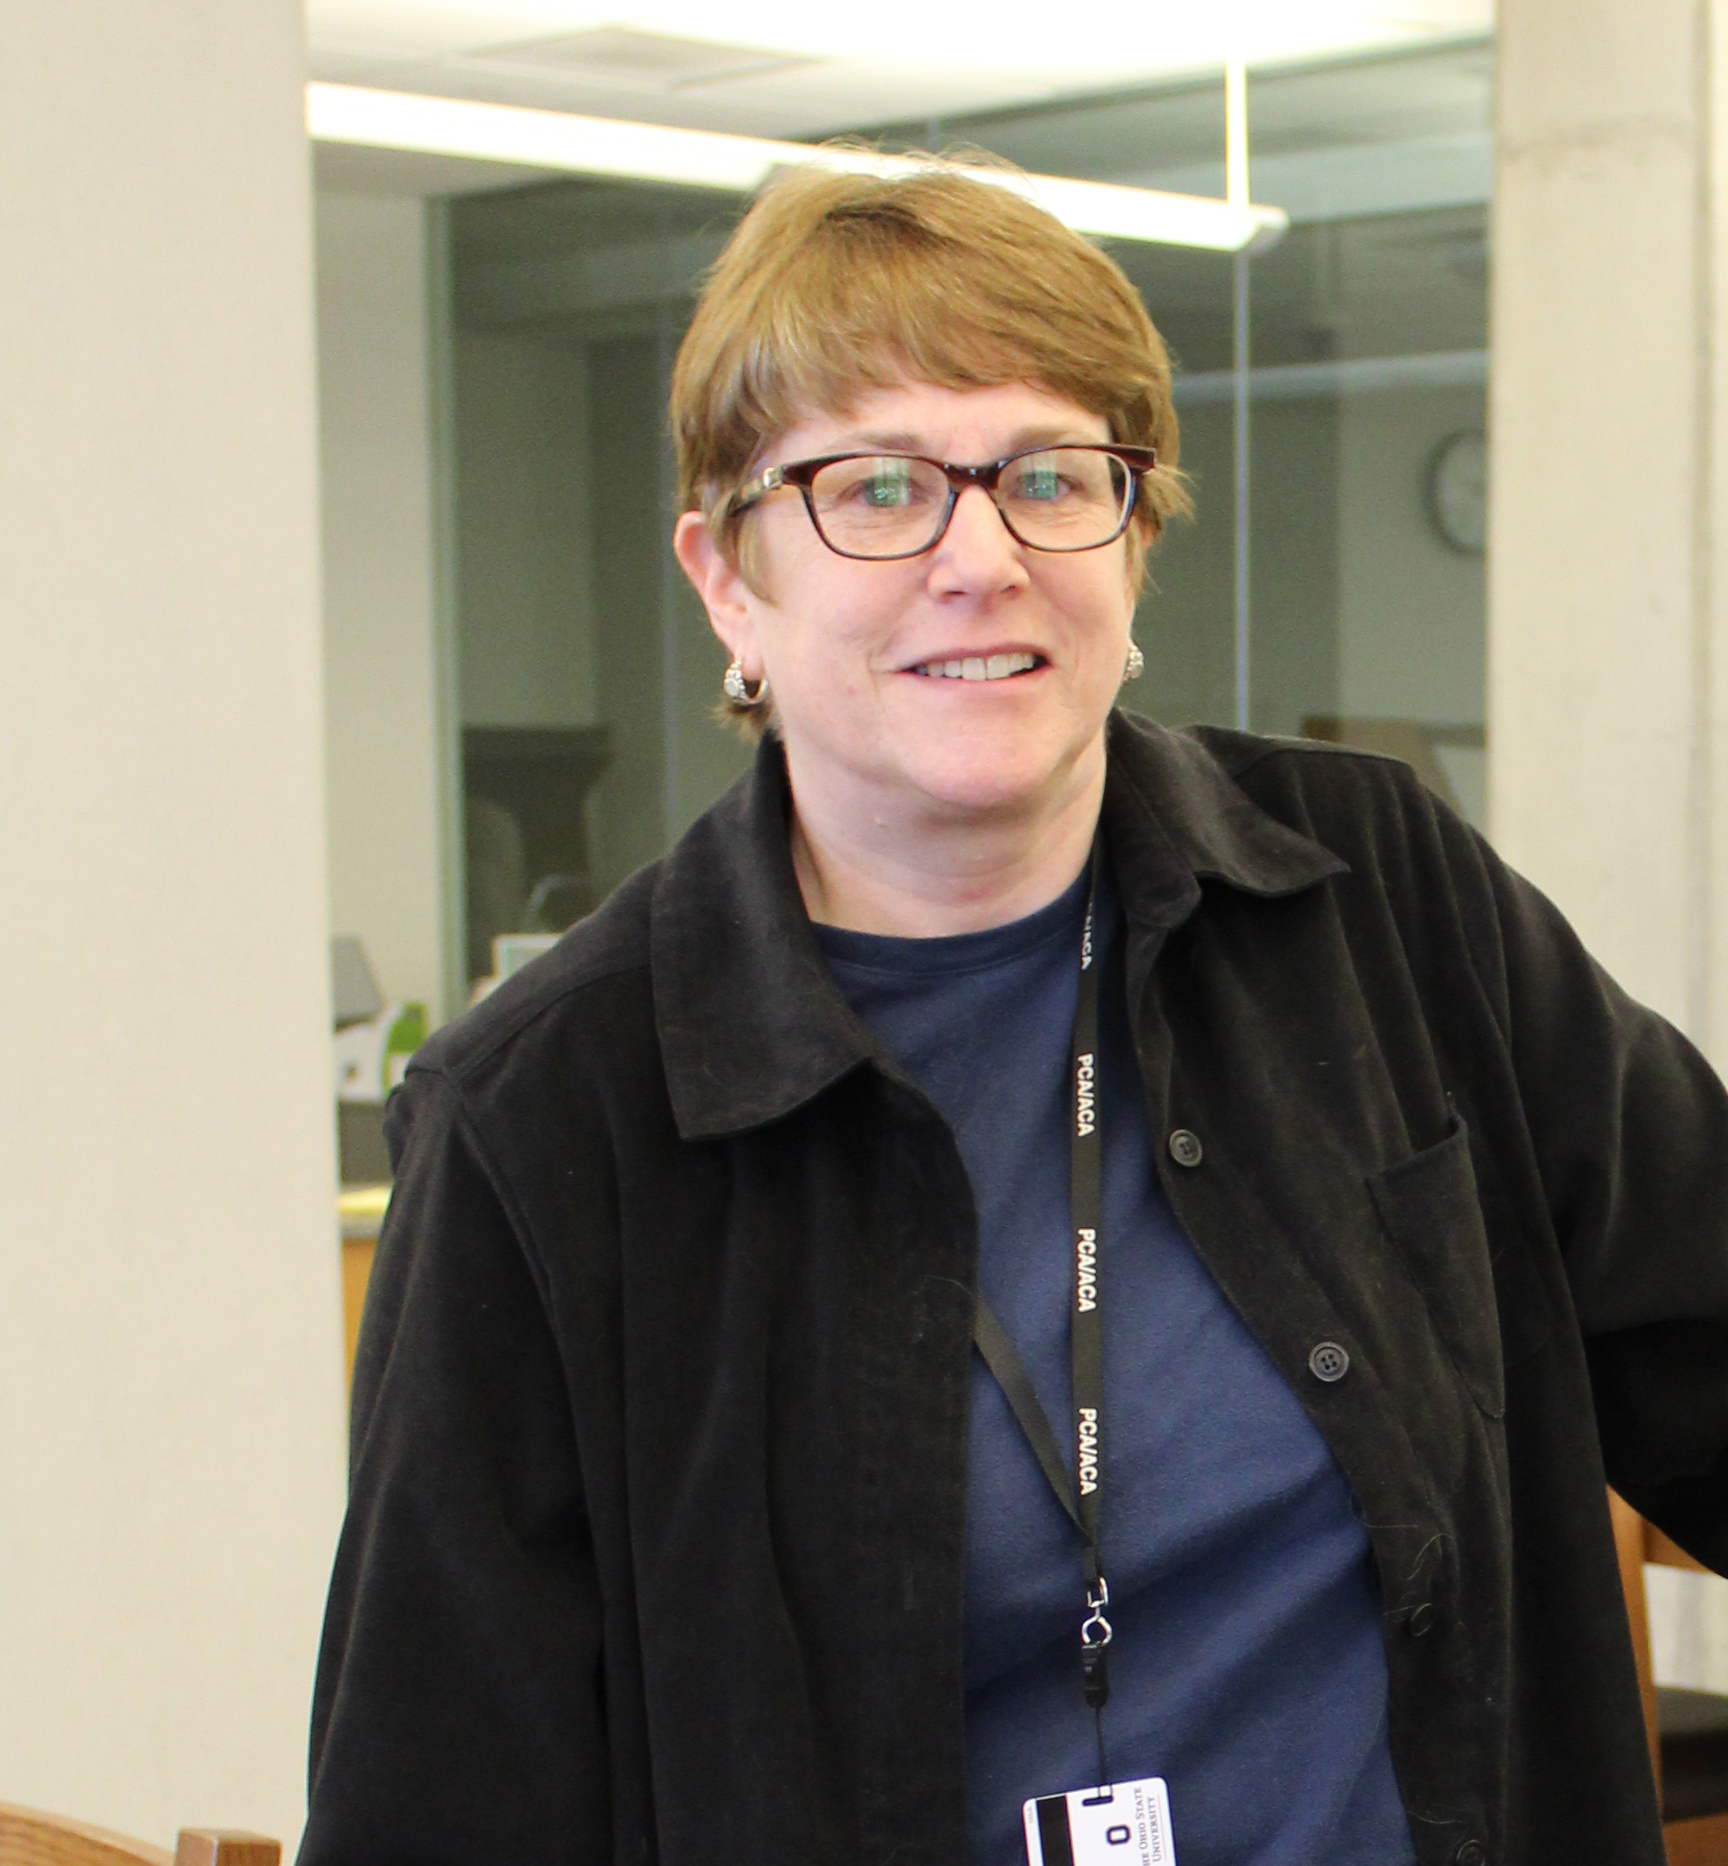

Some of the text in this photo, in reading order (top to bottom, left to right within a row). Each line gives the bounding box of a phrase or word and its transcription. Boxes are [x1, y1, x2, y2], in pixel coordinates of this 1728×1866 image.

[1077, 1053, 1095, 1137] PCA/ACA
[1077, 1228, 1097, 1313] PCA/ACA
[1079, 1407, 1098, 1496] PCA/ACA
